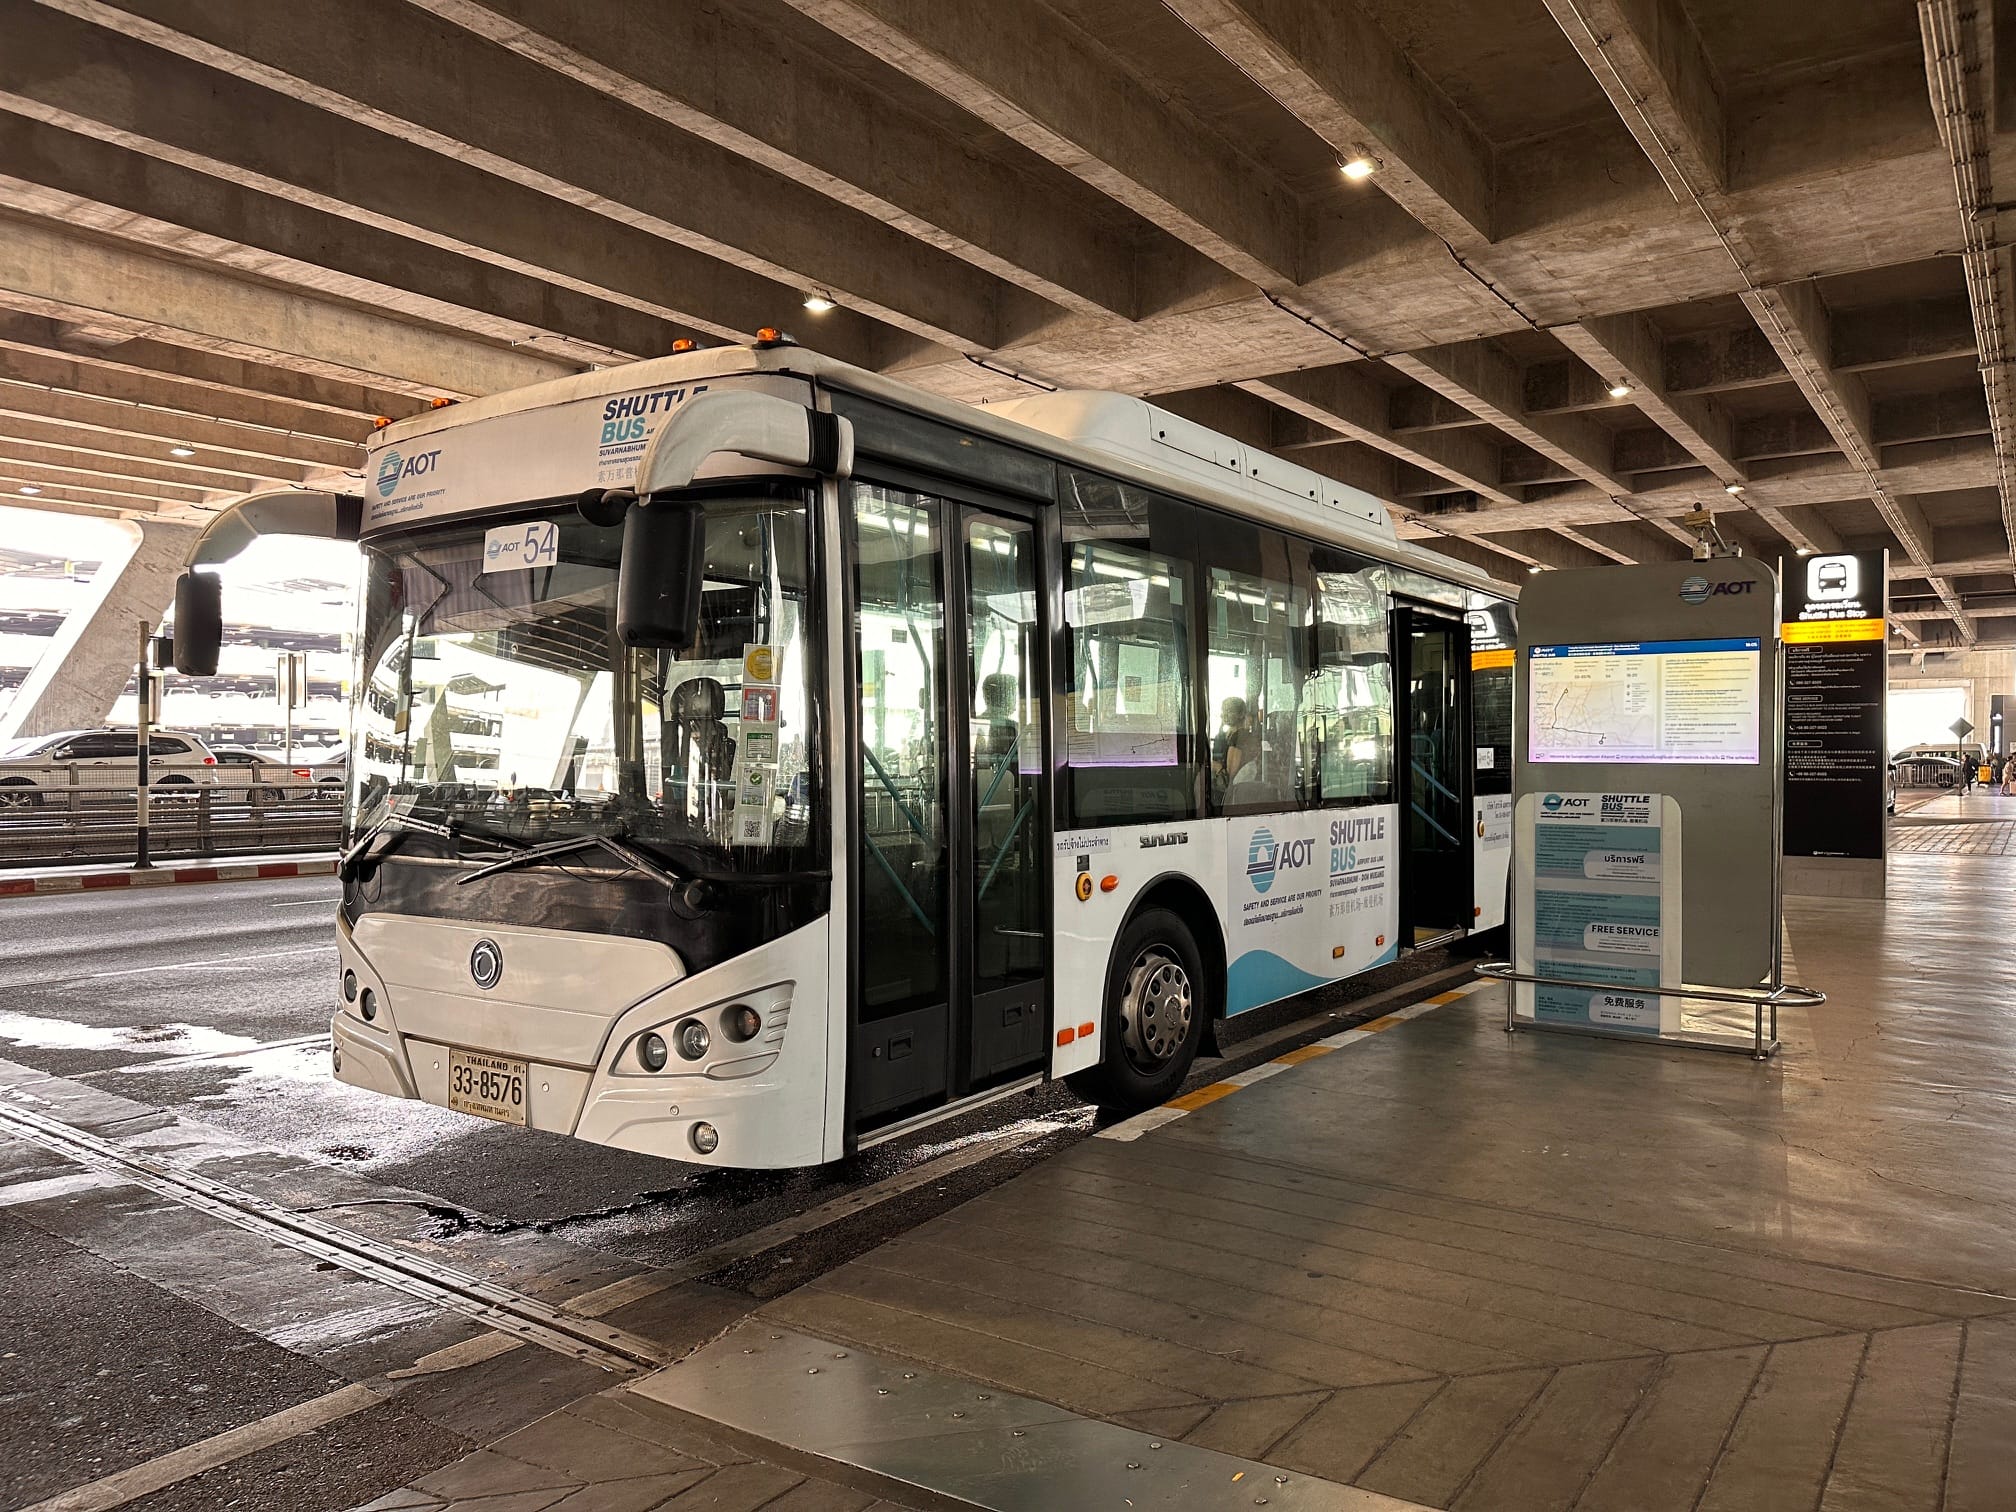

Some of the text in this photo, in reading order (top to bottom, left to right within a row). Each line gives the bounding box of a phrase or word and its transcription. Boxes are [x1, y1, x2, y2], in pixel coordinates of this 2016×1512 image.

[602, 386, 708, 421] SHUTT
[600, 417, 645, 444] BUS
[599, 443, 647, 457] SUVARNABHUM
[402, 449, 442, 479] AOT
[417, 492, 426, 500] OUR
[501, 523, 556, 564] AOT 54
[1712, 580, 1757, 596] AOT
[1828, 610, 1846, 619] Bus
[1846, 609, 1867, 619] Stop
[1563, 798, 1591, 807] AOT
[1601, 794, 1651, 804] SHUTTLE
[1601, 802, 1624, 811] BUS
[1329, 816, 1385, 846] SHUTTLE
[1279, 838, 1316, 870] AOT
[1330, 845, 1356, 873] BUS
[1604, 854, 1645, 864] บริการฟรี
[1243, 901, 1260, 912] SAFETY
[1260, 899, 1270, 908] AND
[1270, 895, 1287, 906] SERVICE
[1288, 893, 1296, 902] ARE
[1296, 892, 1305, 900] OUR
[1305, 889, 1322, 898] PRIORITY
[1591, 924, 1615, 934] FREE
[1617, 926, 1659, 937] SERVICE
[1603, 995, 1646, 1010] 免费服务
[466, 1055, 508, 1071] THAILAND
[453, 1065, 522, 1106] 33-8576
